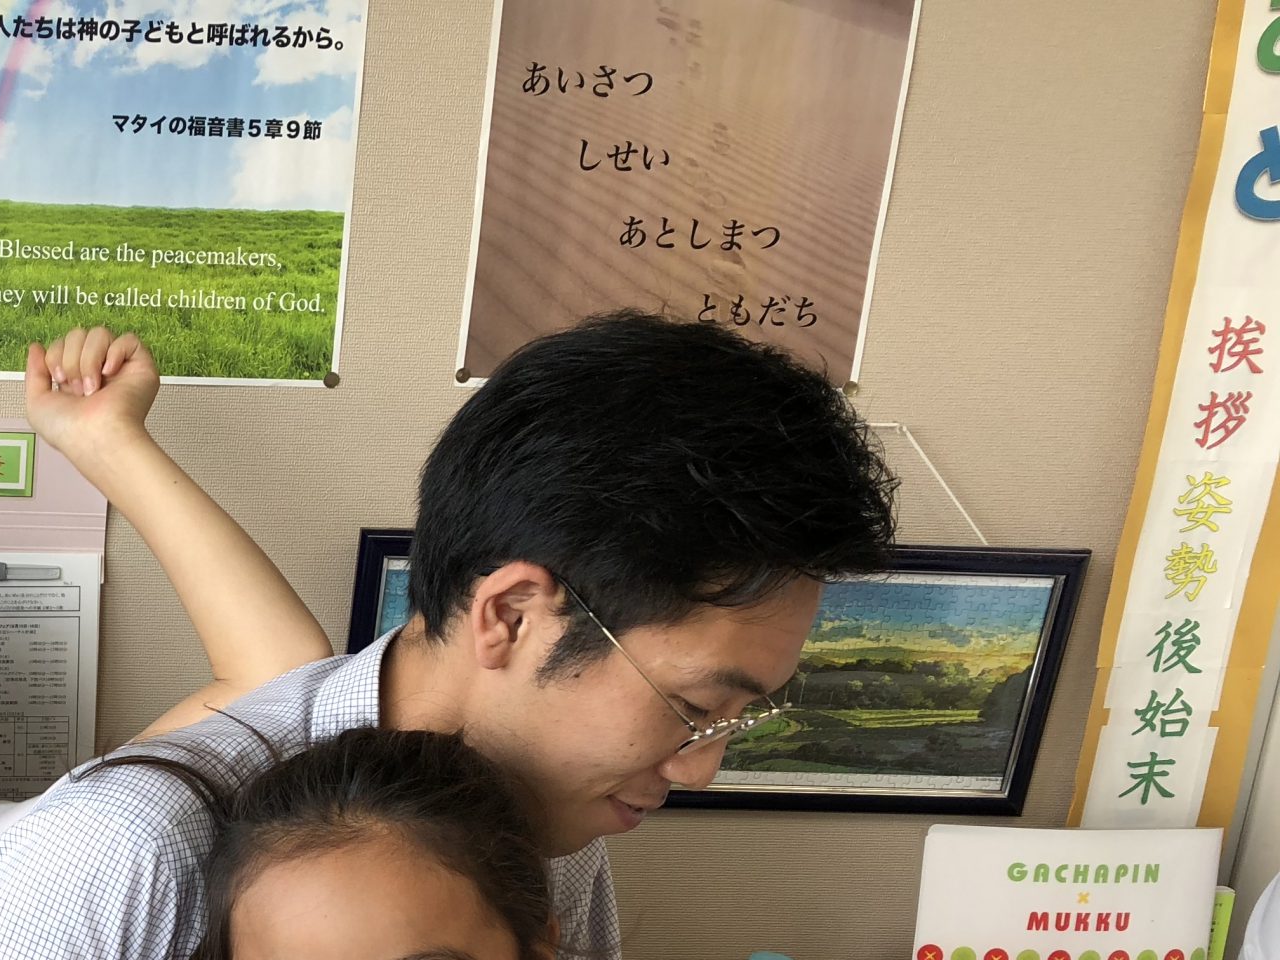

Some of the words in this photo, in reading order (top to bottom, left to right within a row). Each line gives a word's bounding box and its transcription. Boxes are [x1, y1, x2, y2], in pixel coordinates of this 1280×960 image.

[521, 60, 655, 98] あいさつ
[577, 138, 671, 173] しせい
[619, 215, 782, 252] あとしまつ
[80, 245, 110, 262] are
[116, 243, 146, 263] the
[151, 247, 283, 270] peacemakers,
[32, 286, 69, 306] will
[75, 287, 99, 306] be
[104, 288, 161, 309] called
[167, 290, 246, 311] children
[253, 292, 277, 311] of
[279, 294, 326, 313] God.
[696, 293, 819, 328] ともだち
[1194, 314, 1266, 450] 挨拶
[1163, 470, 1234, 601] 姿勢
[1118, 617, 1203, 806] 後始末
[1006, 862, 1161, 884] GACHAPIN
[1026, 911, 1131, 932] MUKKU
